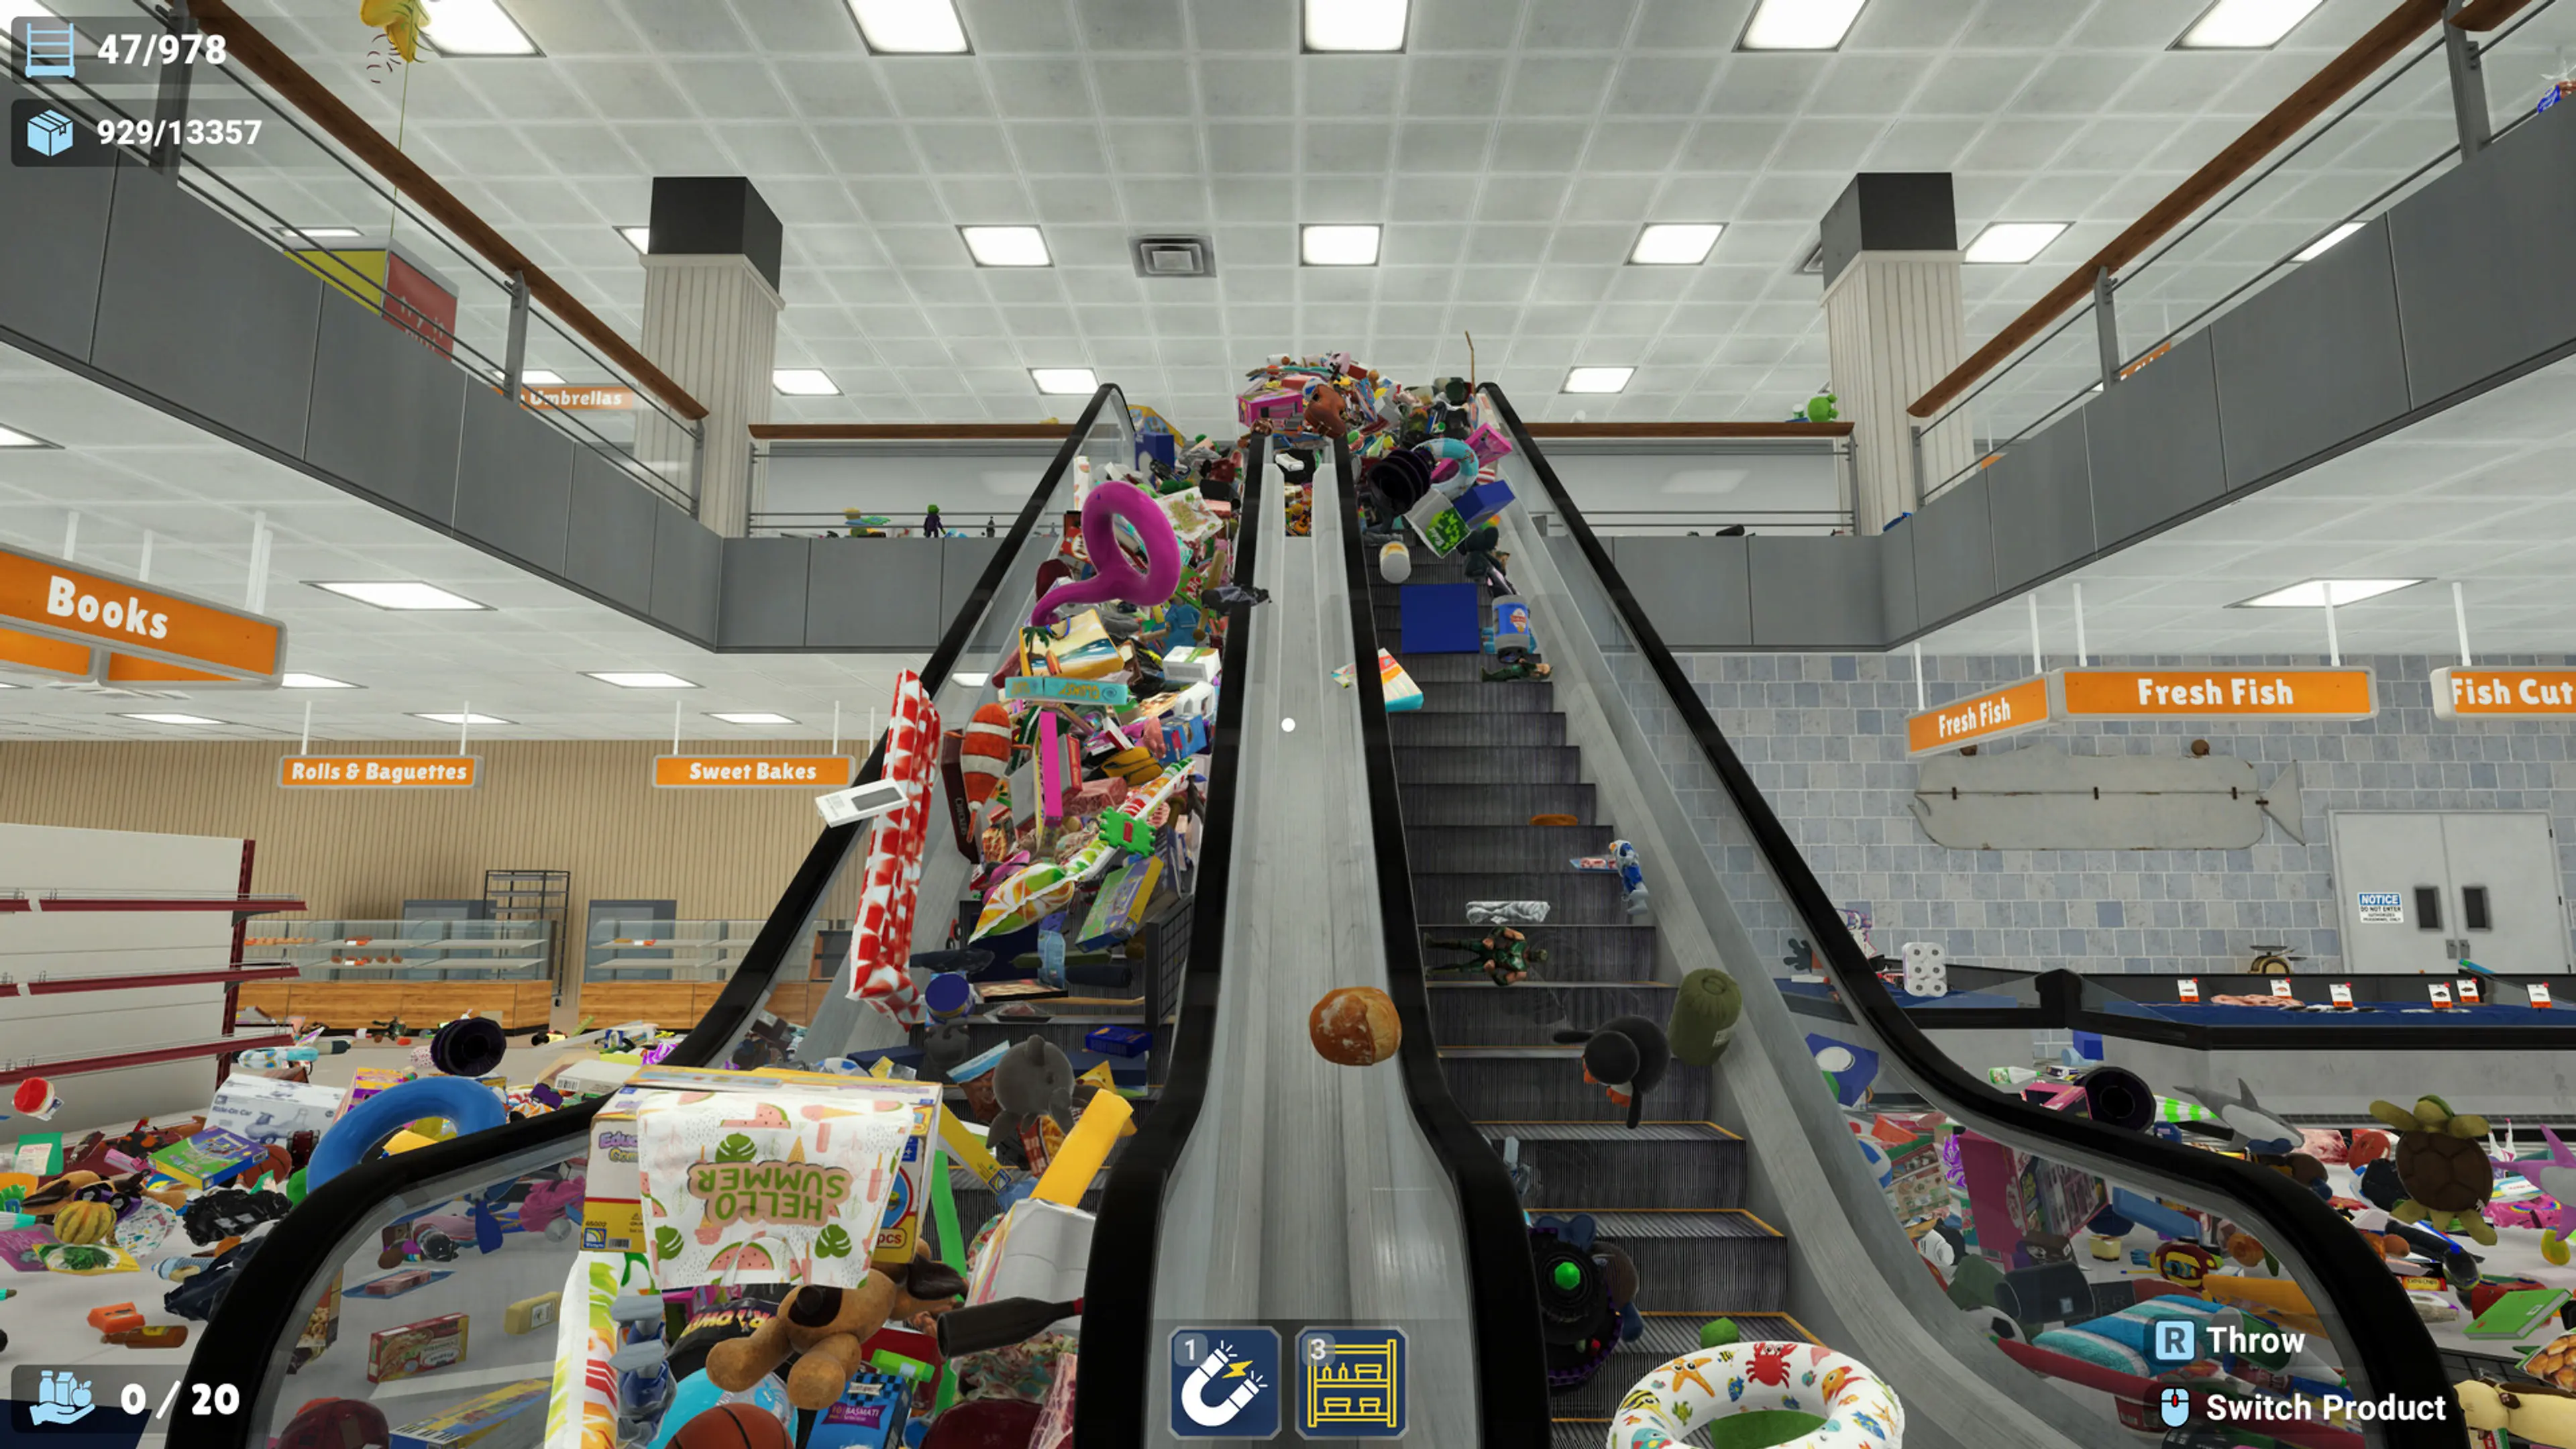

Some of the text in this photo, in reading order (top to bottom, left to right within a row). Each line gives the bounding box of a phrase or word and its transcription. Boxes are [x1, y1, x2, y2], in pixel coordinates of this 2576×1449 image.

[530, 390, 623, 406] Umbrellas
[47, 575, 169, 639] Books
[2138, 679, 2294, 705] Fresh Fish
[2451, 678, 2573, 705] Fish Cut
[1939, 697, 2011, 739] Fresh Fish
[292, 763, 466, 784] Rolls & Baguettes
[690, 762, 816, 780] Sweet Bakes
[2361, 894, 2399, 904] NOTICE
[697, 1167, 849, 1199] SUMMER
[715, 1191, 823, 1222] HELLO
[877, 1234, 902, 1246] pcs
[846, 1405, 880, 1417] BASMATI
